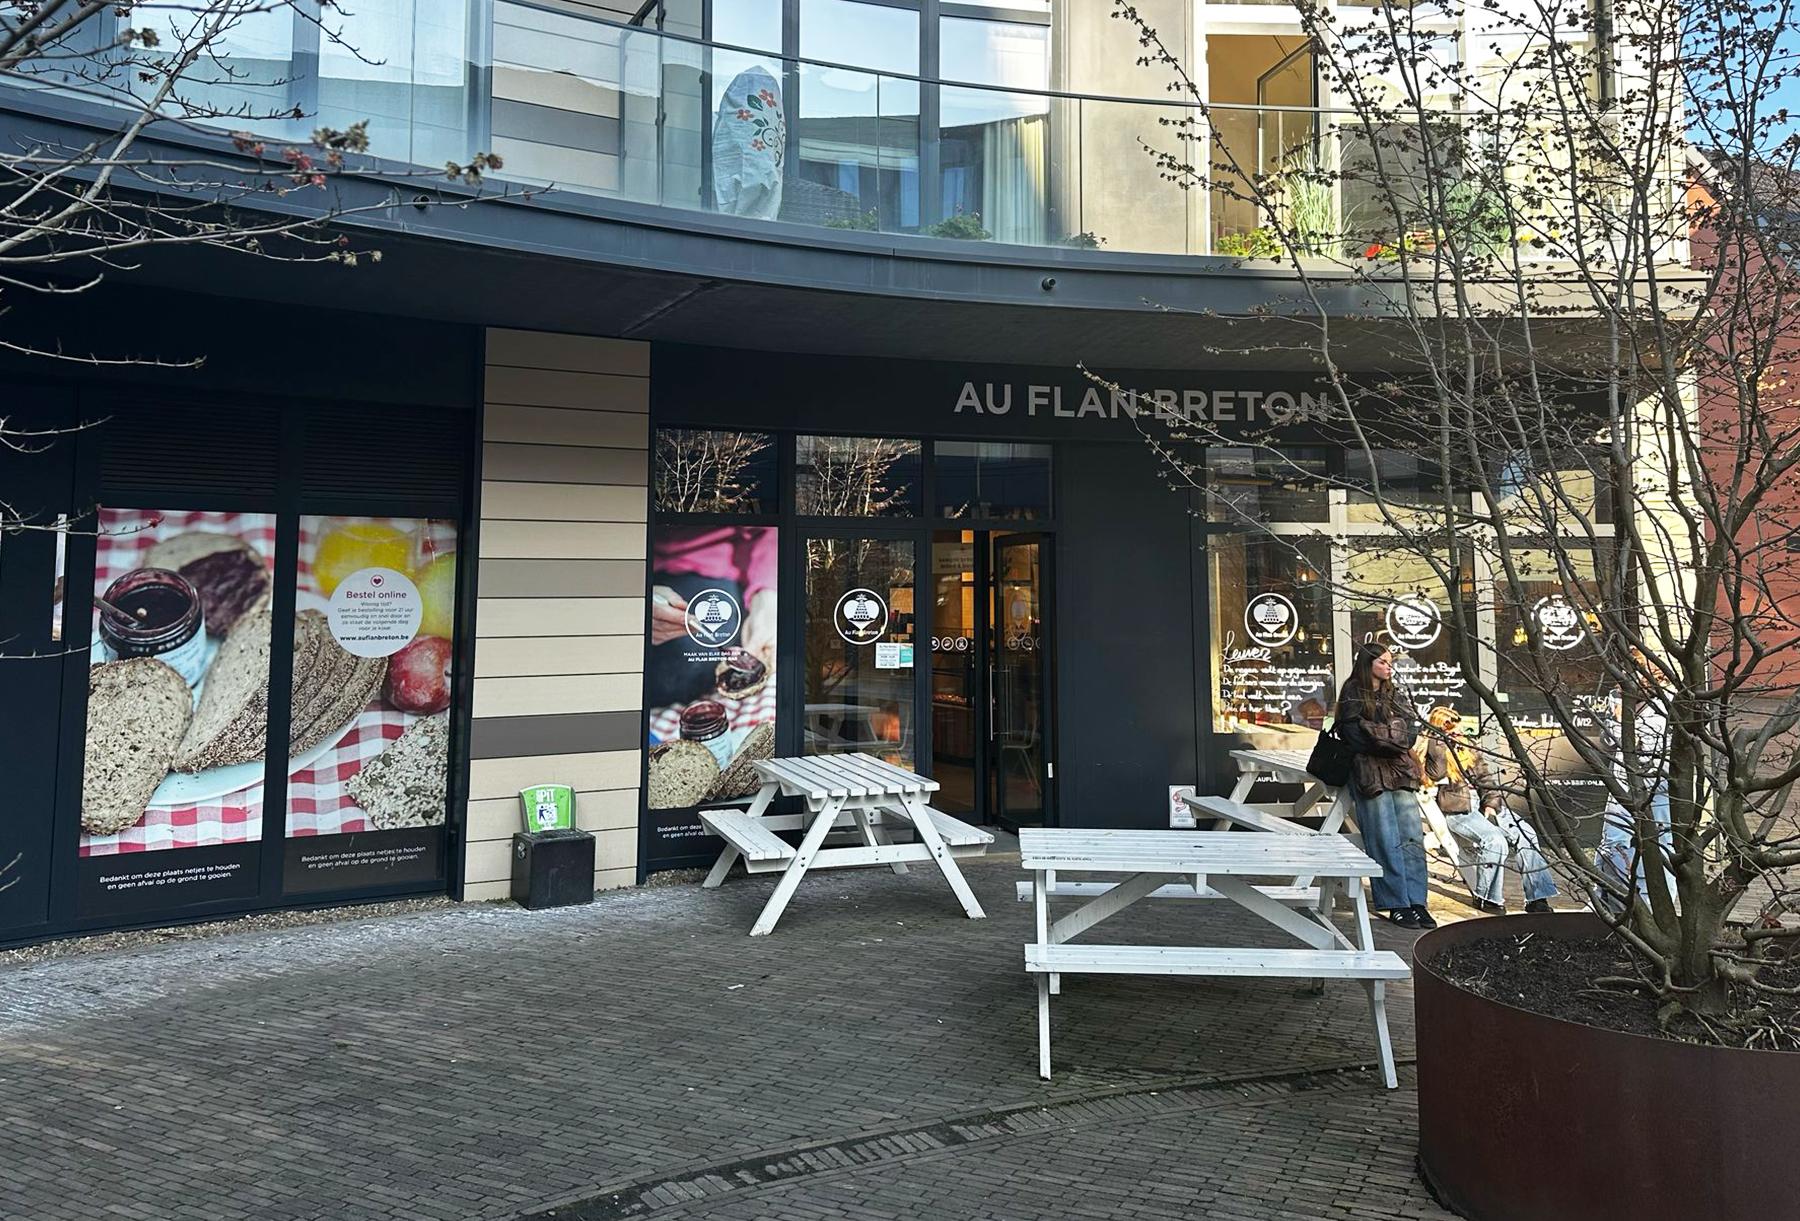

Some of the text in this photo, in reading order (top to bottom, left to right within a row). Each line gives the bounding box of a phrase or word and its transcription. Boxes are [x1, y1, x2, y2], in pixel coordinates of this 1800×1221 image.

[954, 382, 1328, 422] AU FLAN BRETON
[346, 591, 407, 599] Bestel online
[1219, 630, 1272, 661] Leuven
[370, 856, 388, 864] grond
[100, 874, 129, 883] Bedankt
[162, 869, 183, 878] plaats
[185, 866, 205, 876] netjes
[118, 882, 136, 890] geen
[177, 874, 198, 884] grond
